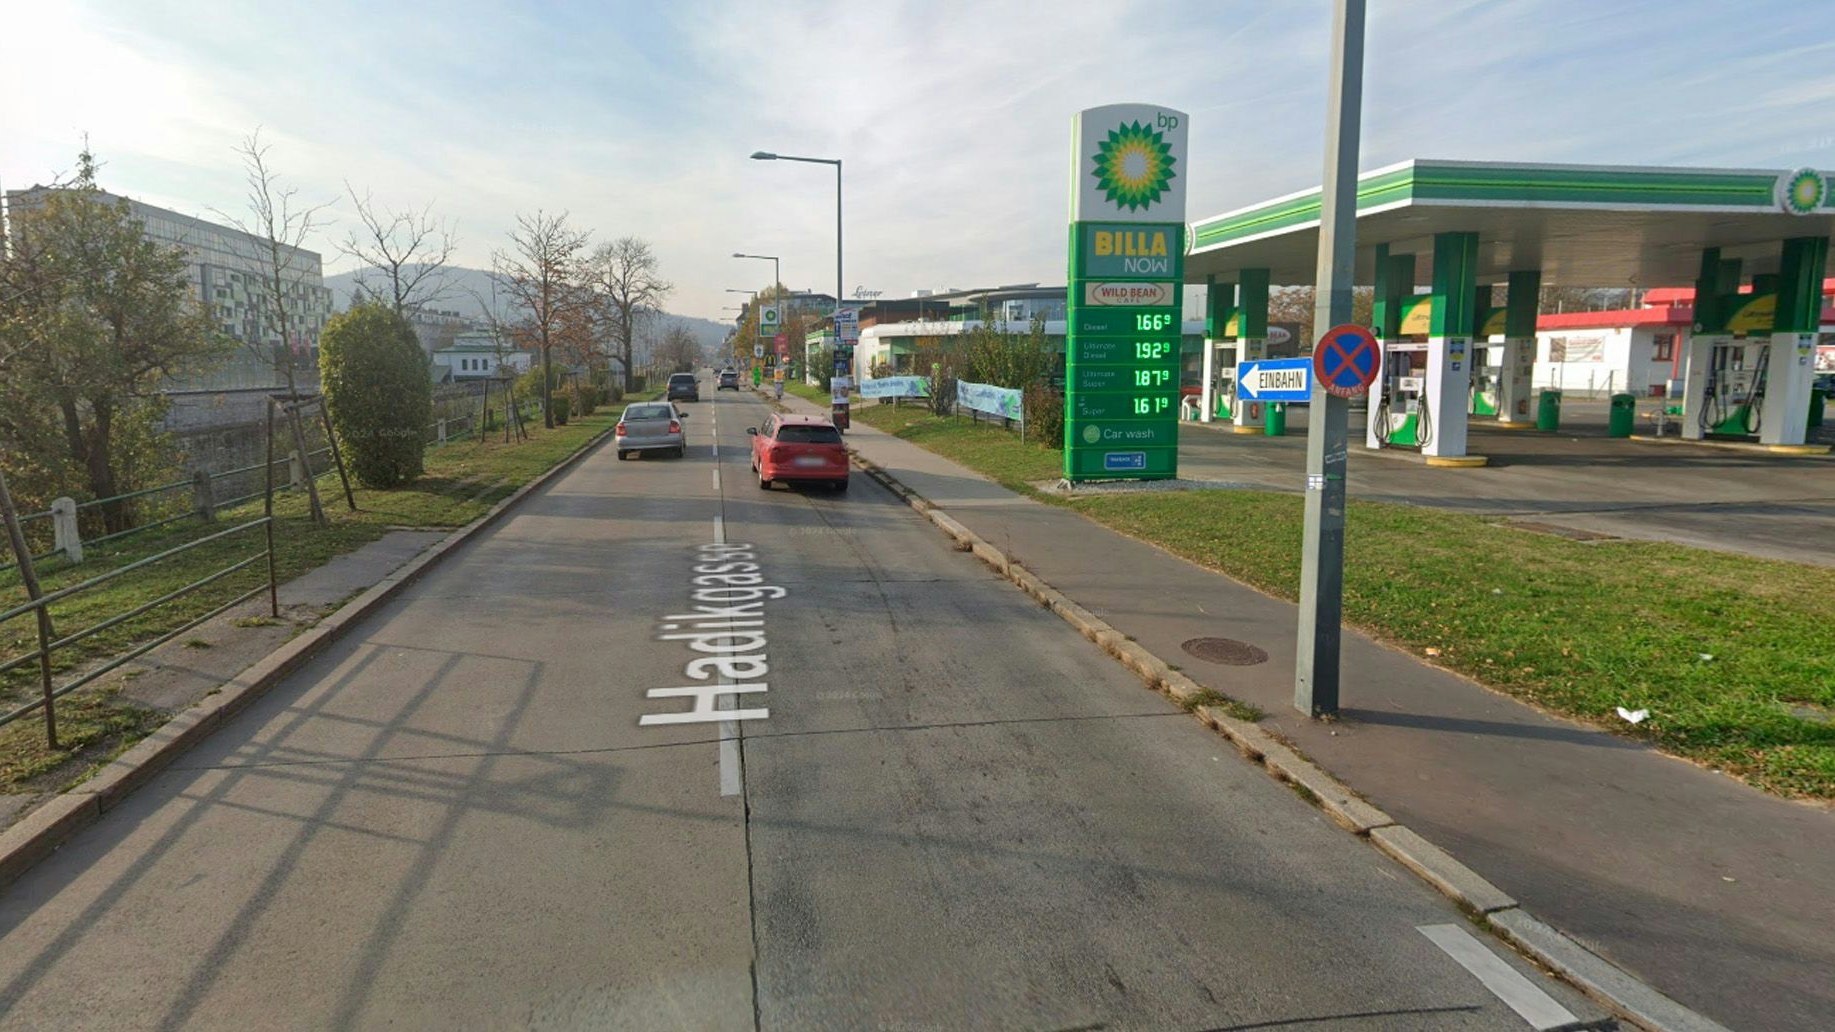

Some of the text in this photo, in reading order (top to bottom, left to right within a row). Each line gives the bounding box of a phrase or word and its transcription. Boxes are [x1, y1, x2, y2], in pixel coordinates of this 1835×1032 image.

[1157, 112, 1178, 132] bp
[1095, 231, 1167, 256] BILLA
[1124, 258, 1167, 273] NOW
[1102, 287, 1157, 298] WILD BEAN
[1259, 371, 1302, 389] EINBAHN
[1328, 382, 1365, 397] ANFANG
[1103, 428, 1154, 439] Car wash
